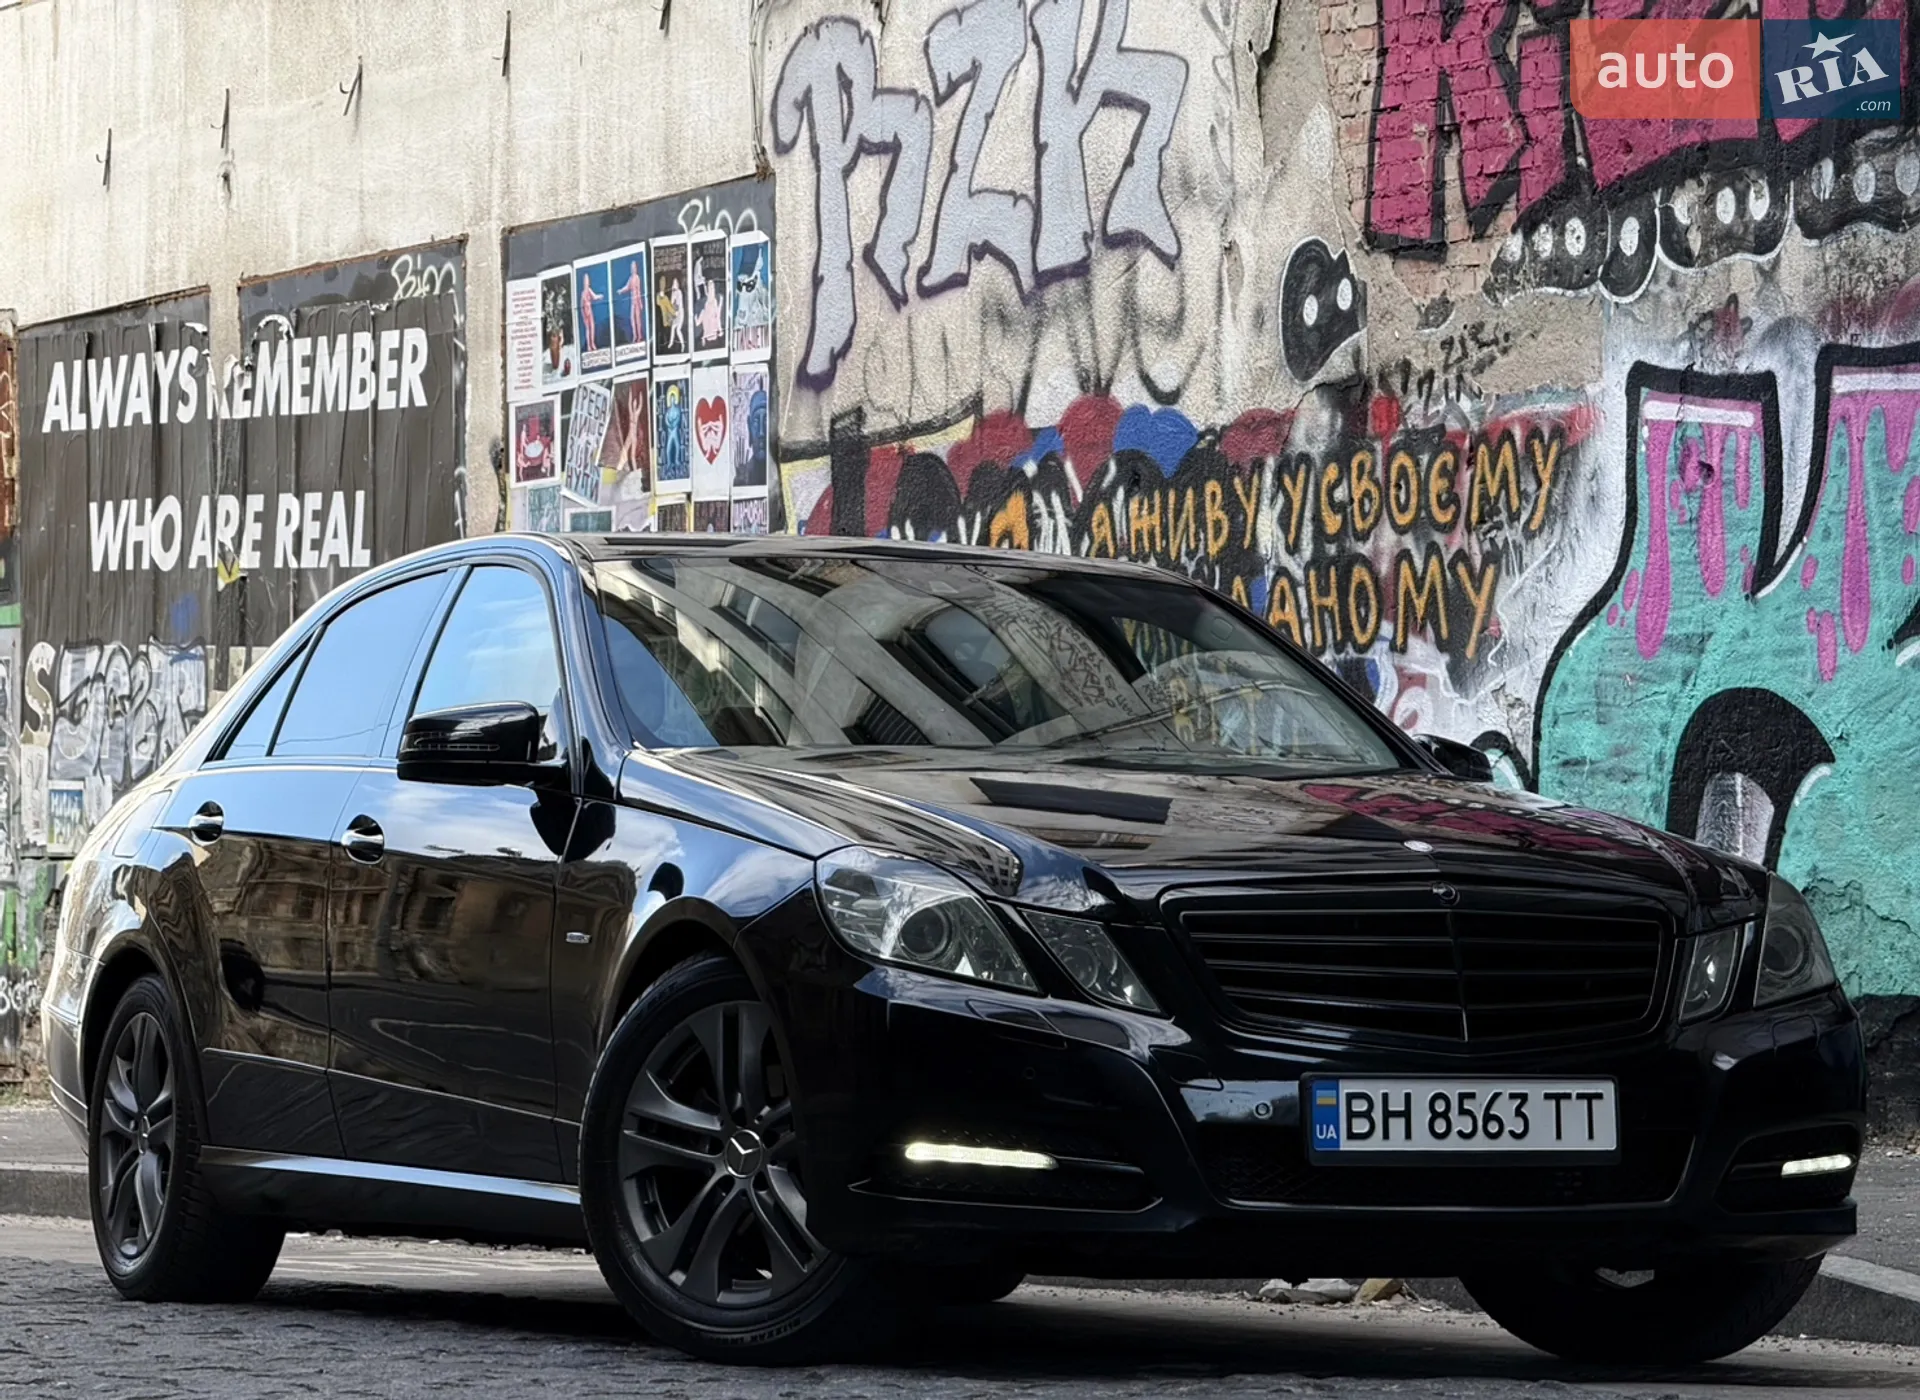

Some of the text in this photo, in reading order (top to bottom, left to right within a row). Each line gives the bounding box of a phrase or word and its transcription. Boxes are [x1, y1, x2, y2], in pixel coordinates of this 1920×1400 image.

[42, 345, 198, 433] ALWAYS
[89, 490, 371, 572] WHO ARE REAL
[1089, 502, 1115, 558] Я
[1128, 470, 1260, 562] ЖИВУ
[1320, 437, 1561, 537] СВОЄМУ
[1316, 1124, 1337, 1140] UA
[1345, 1091, 1603, 1141] BH 8563 TT
